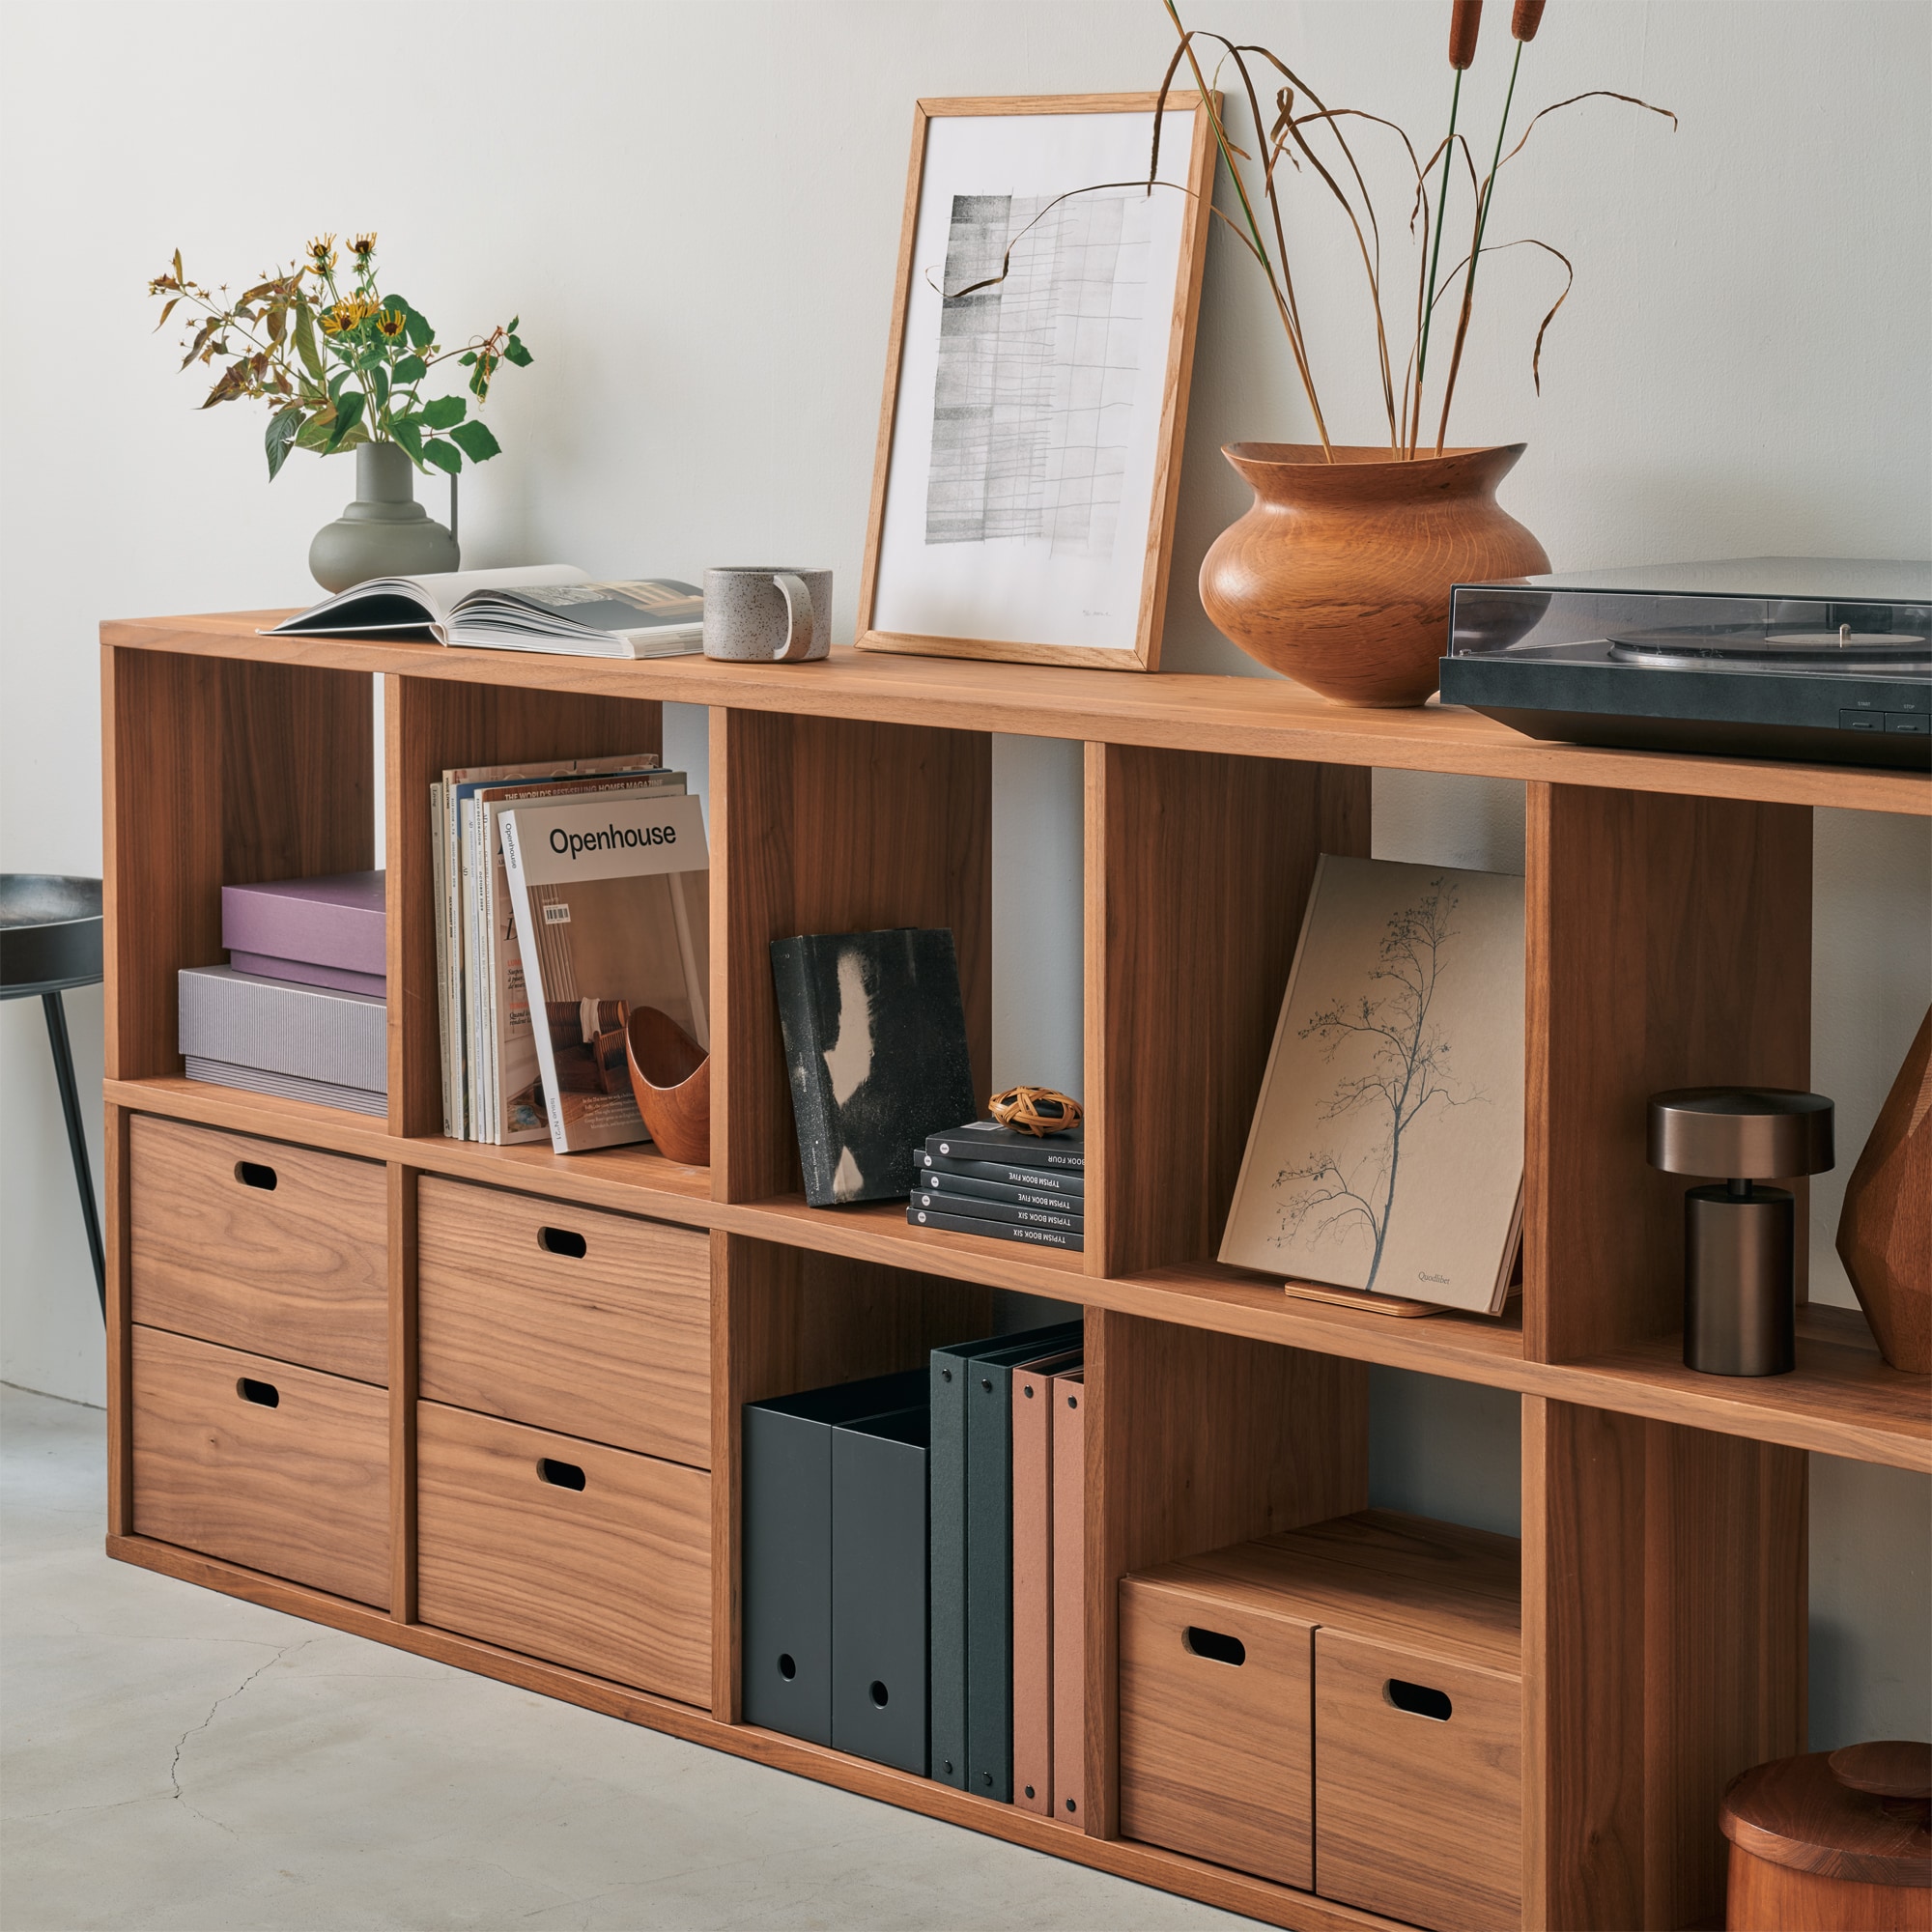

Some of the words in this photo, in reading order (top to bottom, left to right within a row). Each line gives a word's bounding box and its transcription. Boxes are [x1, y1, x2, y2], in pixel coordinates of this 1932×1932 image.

[504, 823, 518, 869] Openhouse
[549, 823, 677, 860] Openhouse
[463, 866, 469, 877] AD
[1047, 1155, 1066, 1164] FOUR
[1009, 1172, 1021, 1180] FIVE
[1022, 1175, 1037, 1183] BOOK
[1038, 1178, 1059, 1187] TYPISM
[1017, 1193, 1031, 1202] FIVE
[1031, 1195, 1048, 1205] BOOK
[1048, 1199, 1070, 1208] TYPISM
[1029, 1212, 1047, 1222] BOOK
[1048, 1216, 1070, 1226] TYPISM
[1024, 1231, 1042, 1239] BOOK
[1043, 1234, 1065, 1243] TYPISM
[1417, 1270, 1451, 1285] Quodlibet
